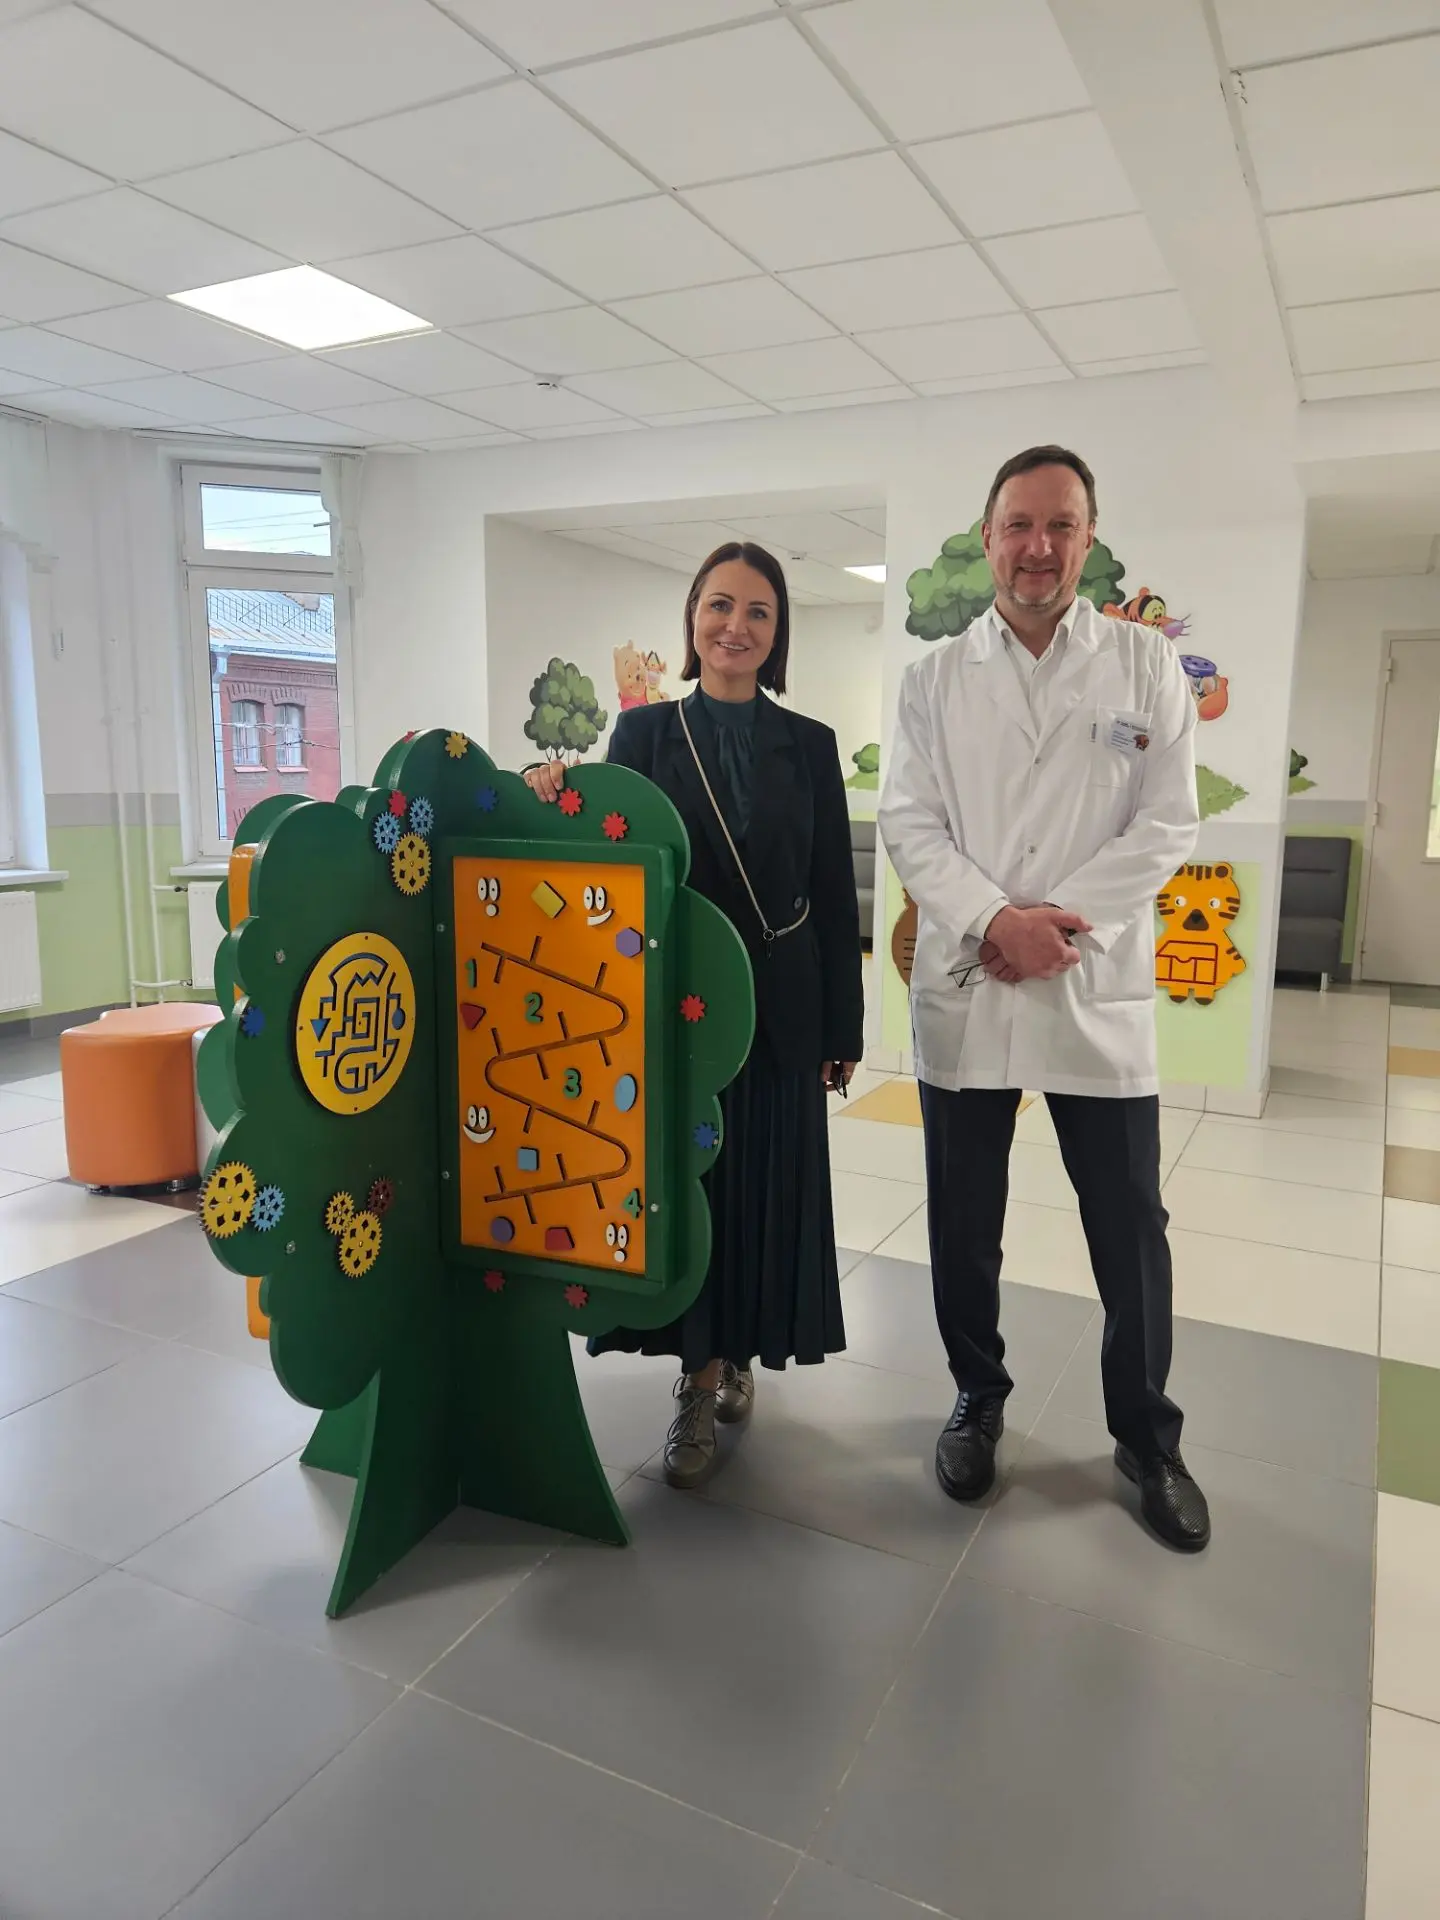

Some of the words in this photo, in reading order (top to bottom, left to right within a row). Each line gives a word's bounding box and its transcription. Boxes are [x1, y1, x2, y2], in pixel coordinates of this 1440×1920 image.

[465, 958, 477, 988] 1
[525, 992, 543, 1023] 2
[563, 1068, 582, 1099] 3
[624, 1188, 643, 1219] 4
